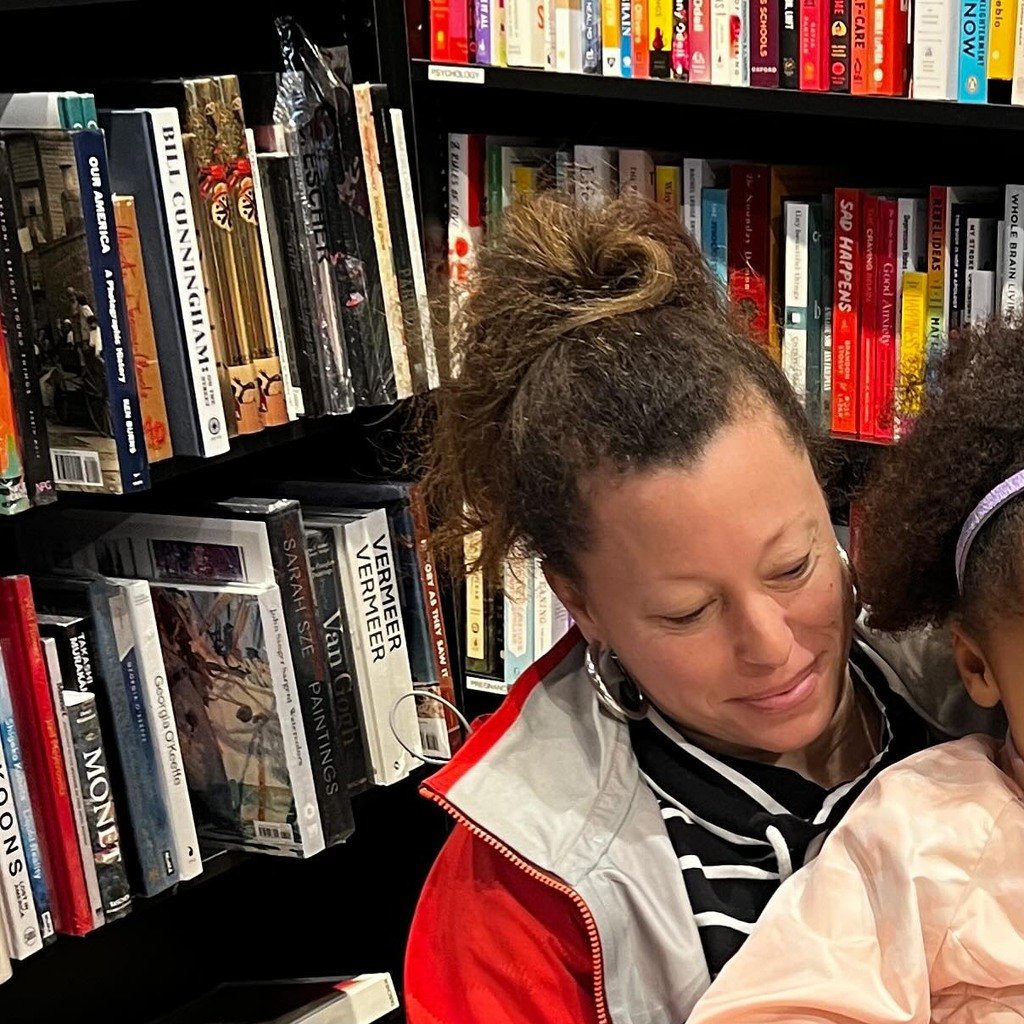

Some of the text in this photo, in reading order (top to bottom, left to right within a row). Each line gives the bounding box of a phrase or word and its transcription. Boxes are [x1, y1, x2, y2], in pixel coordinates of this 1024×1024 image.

[431, 69, 479, 79] PSYCHOLOGY
[759, 12, 768, 57] SCHOOLS
[962, 2, 977, 57] NOW
[88, 156, 111, 254] OUR AMERICA
[163, 125, 209, 373] BILL CUNNINGHAM:
[838, 199, 854, 313] SAD HAPPENS
[1008, 193, 1020, 275] WHOLE BRAIN
[357, 545, 386, 665] VERMEER
[372, 533, 402, 653] VERMEER
[154, 675, 182, 786] Georgia O'Keeffe
[308, 681, 339, 796] PAINTINGS
[83, 750, 122, 862] MONET
